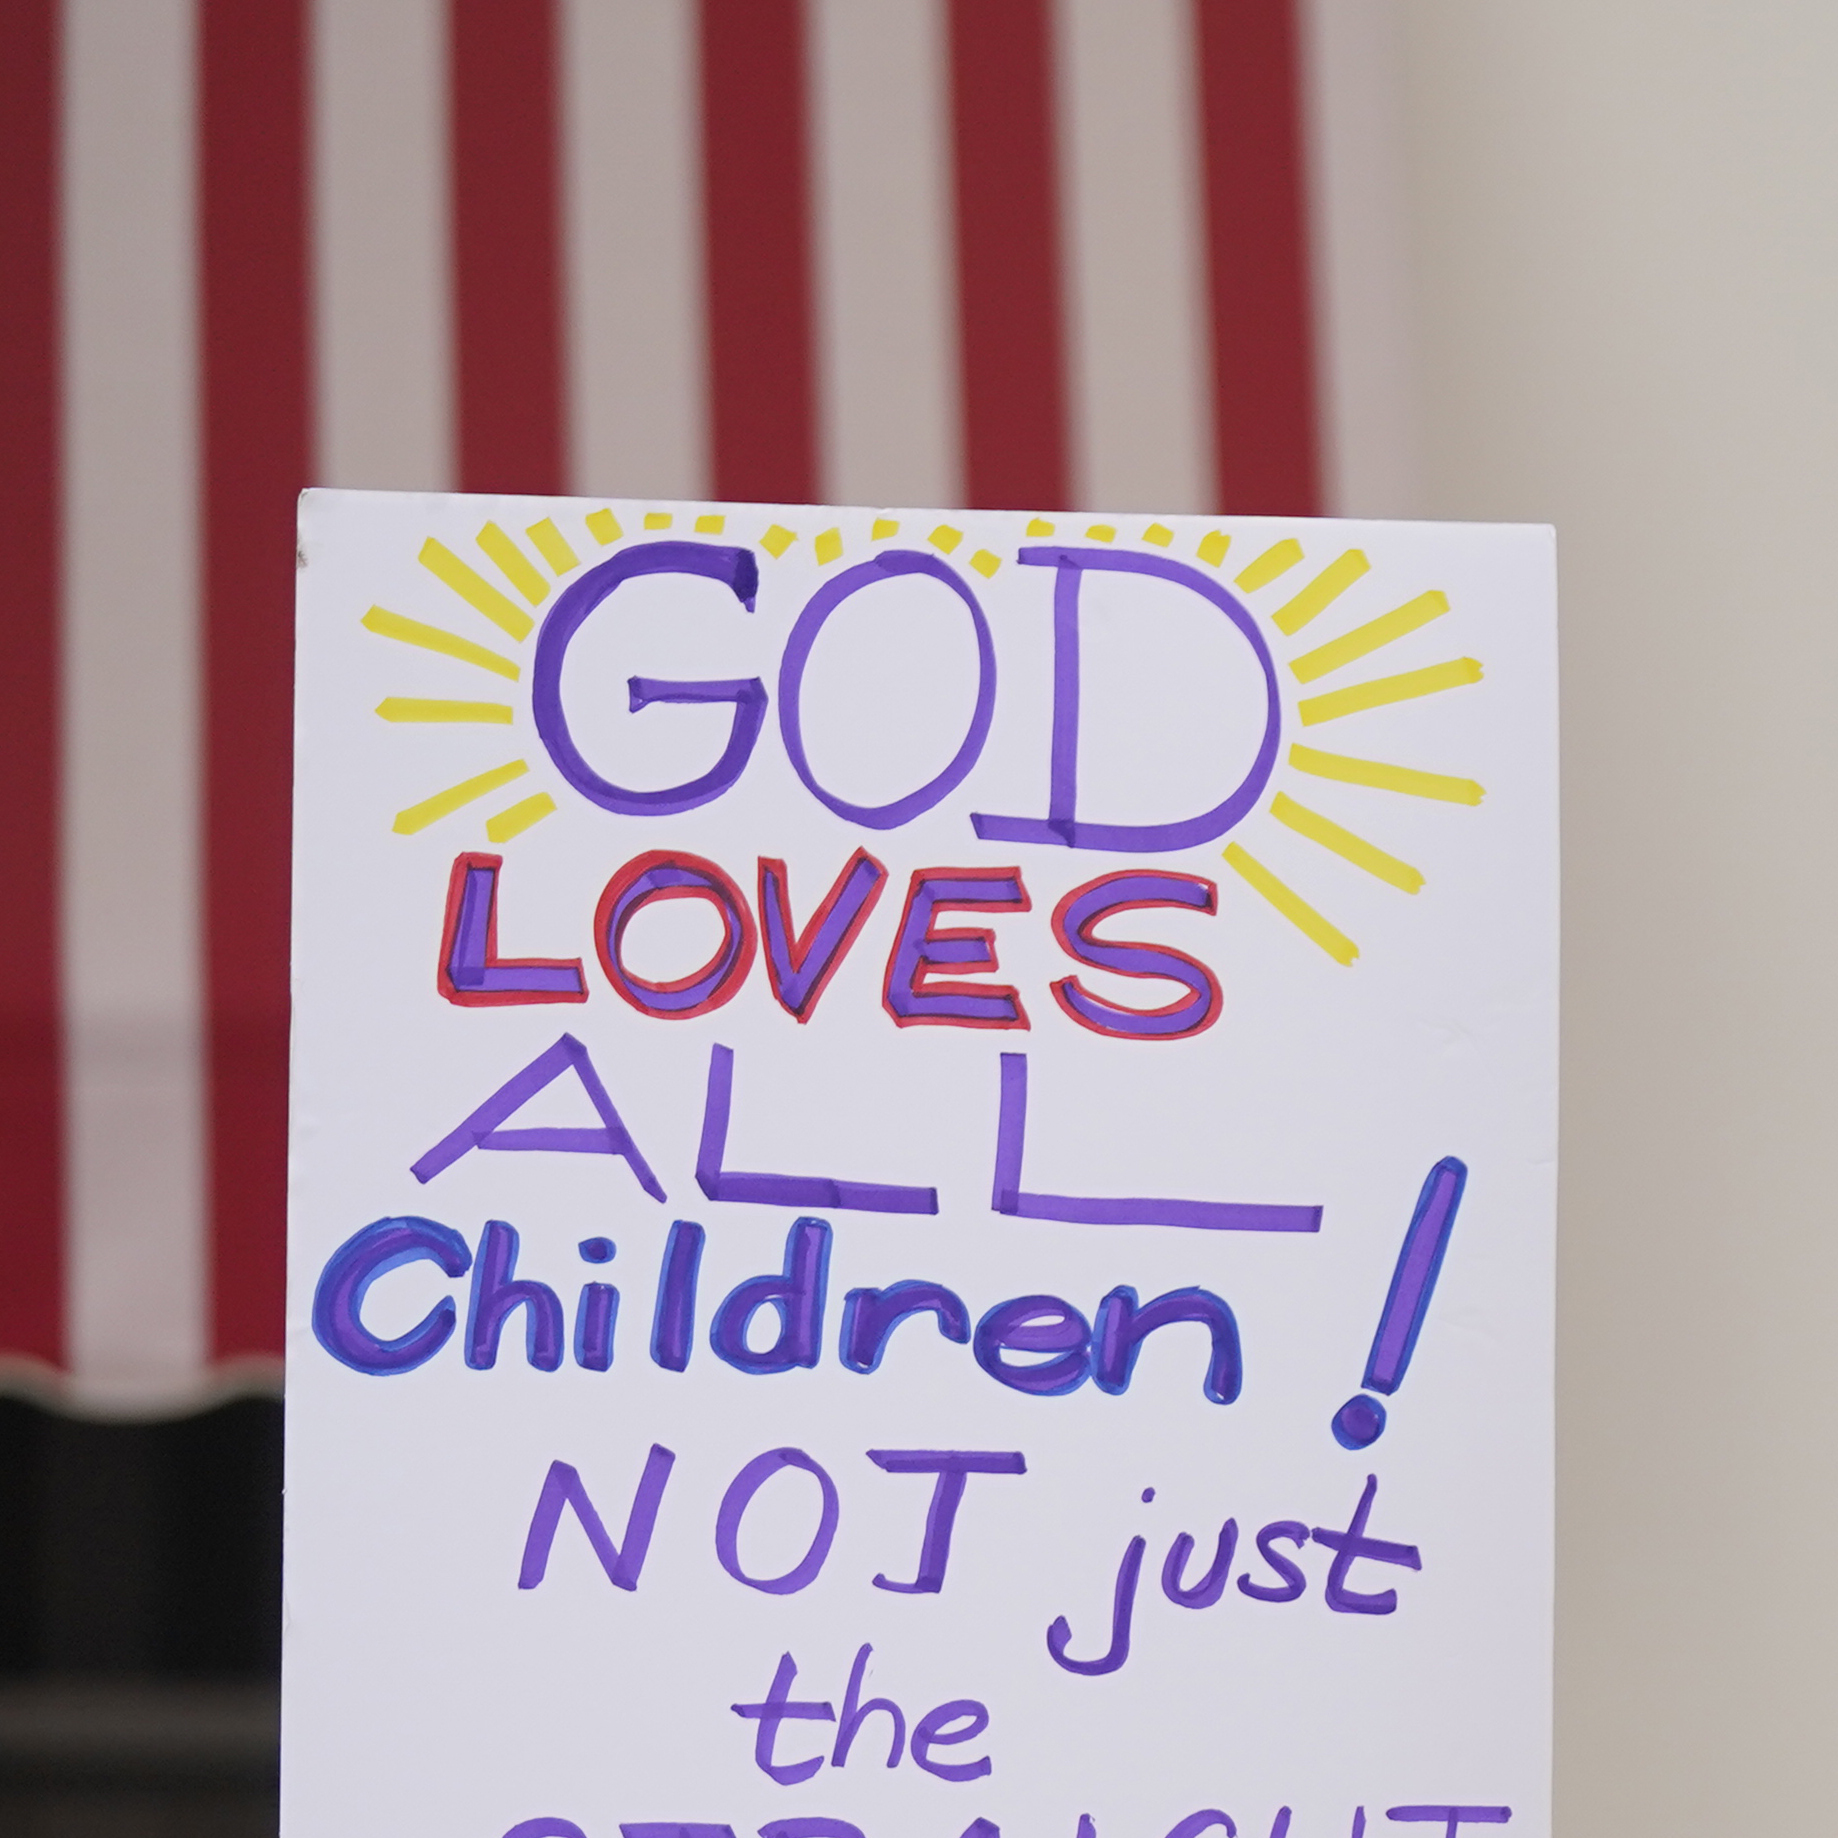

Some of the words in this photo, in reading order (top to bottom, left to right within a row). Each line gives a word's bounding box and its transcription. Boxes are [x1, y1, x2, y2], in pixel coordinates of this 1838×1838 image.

[532, 540, 1282, 854] GOD
[437, 845, 1224, 1042] LOVES
[409, 1032, 1324, 1233] ALL
[517, 1443, 1027, 1596] NOT
[1046, 1472, 1422, 1677] just
[730, 1642, 993, 1786] the
